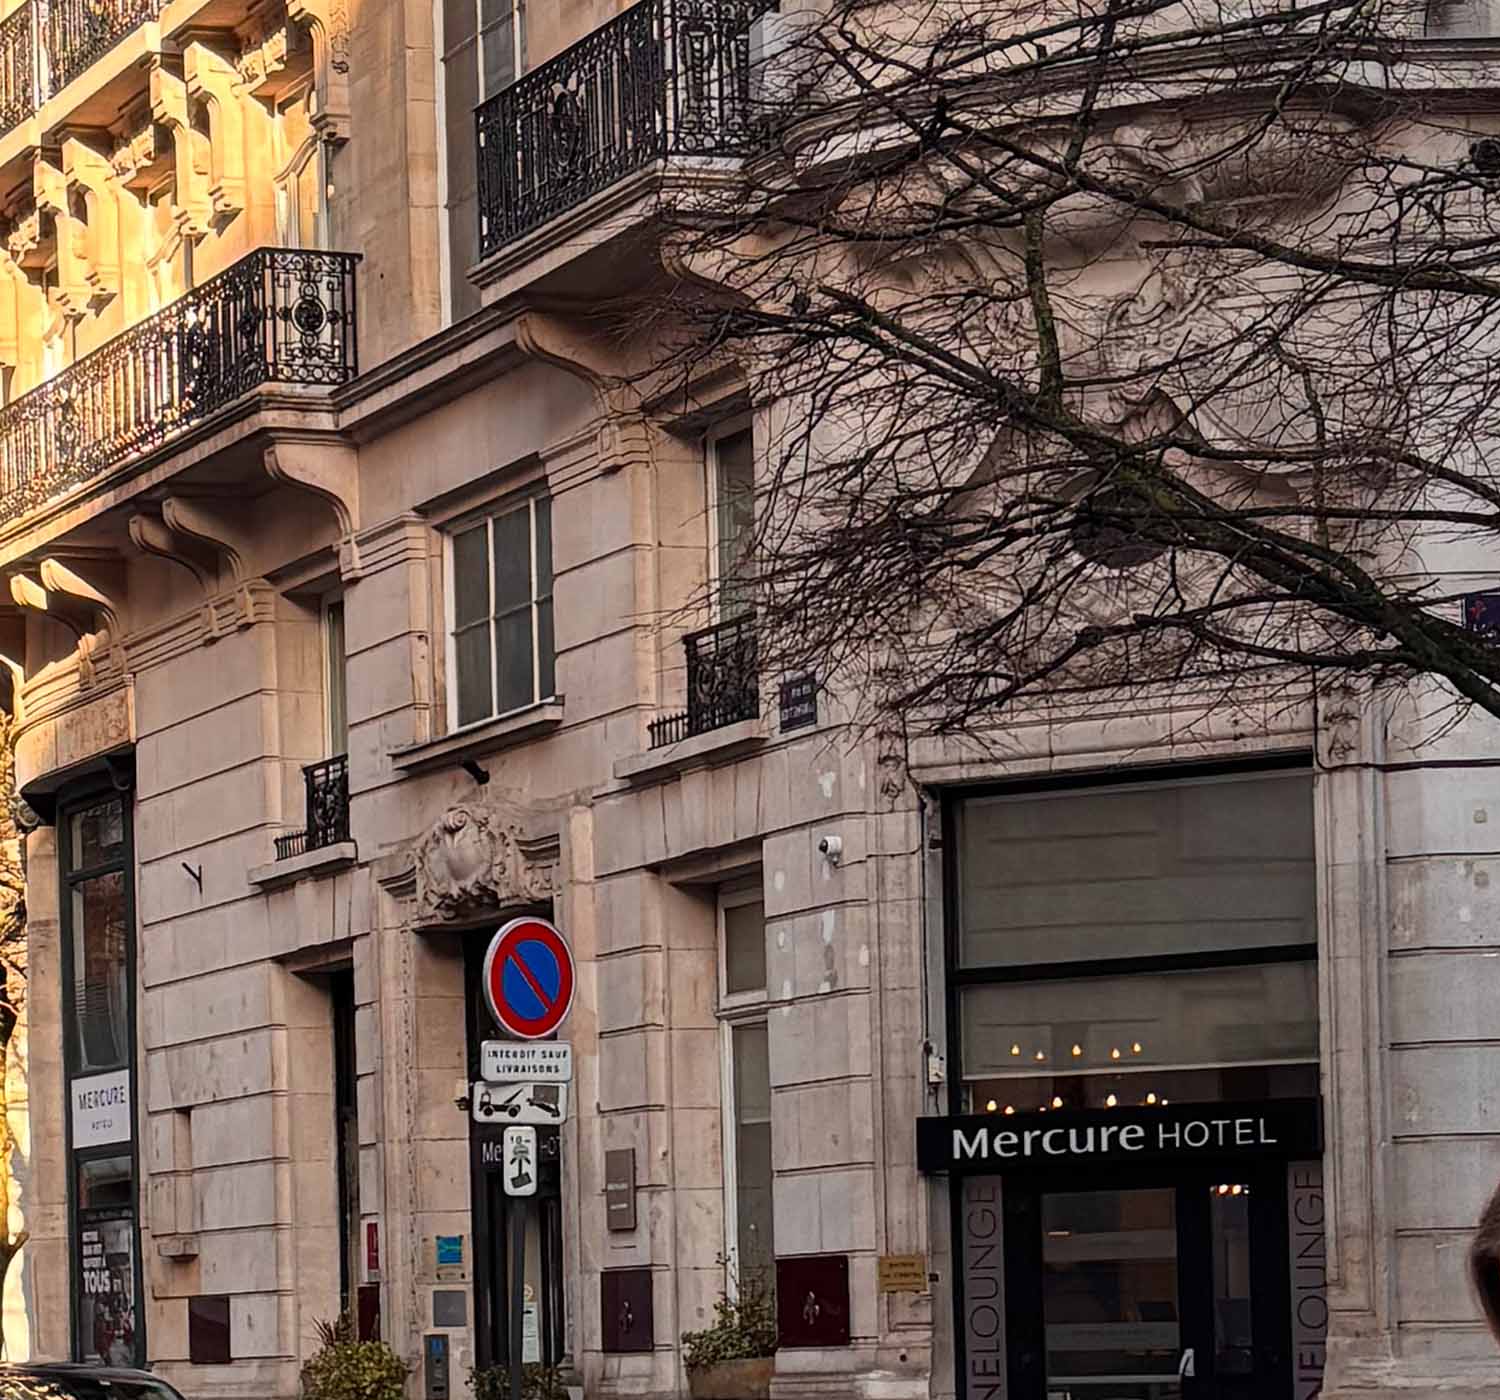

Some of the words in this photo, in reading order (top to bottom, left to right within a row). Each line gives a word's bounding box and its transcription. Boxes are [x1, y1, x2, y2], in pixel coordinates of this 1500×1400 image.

[496, 1064, 560, 1073] LIVRAISONS
[953, 1124, 1144, 1159] Mercure
[1158, 1118, 1277, 1148] HOTEL
